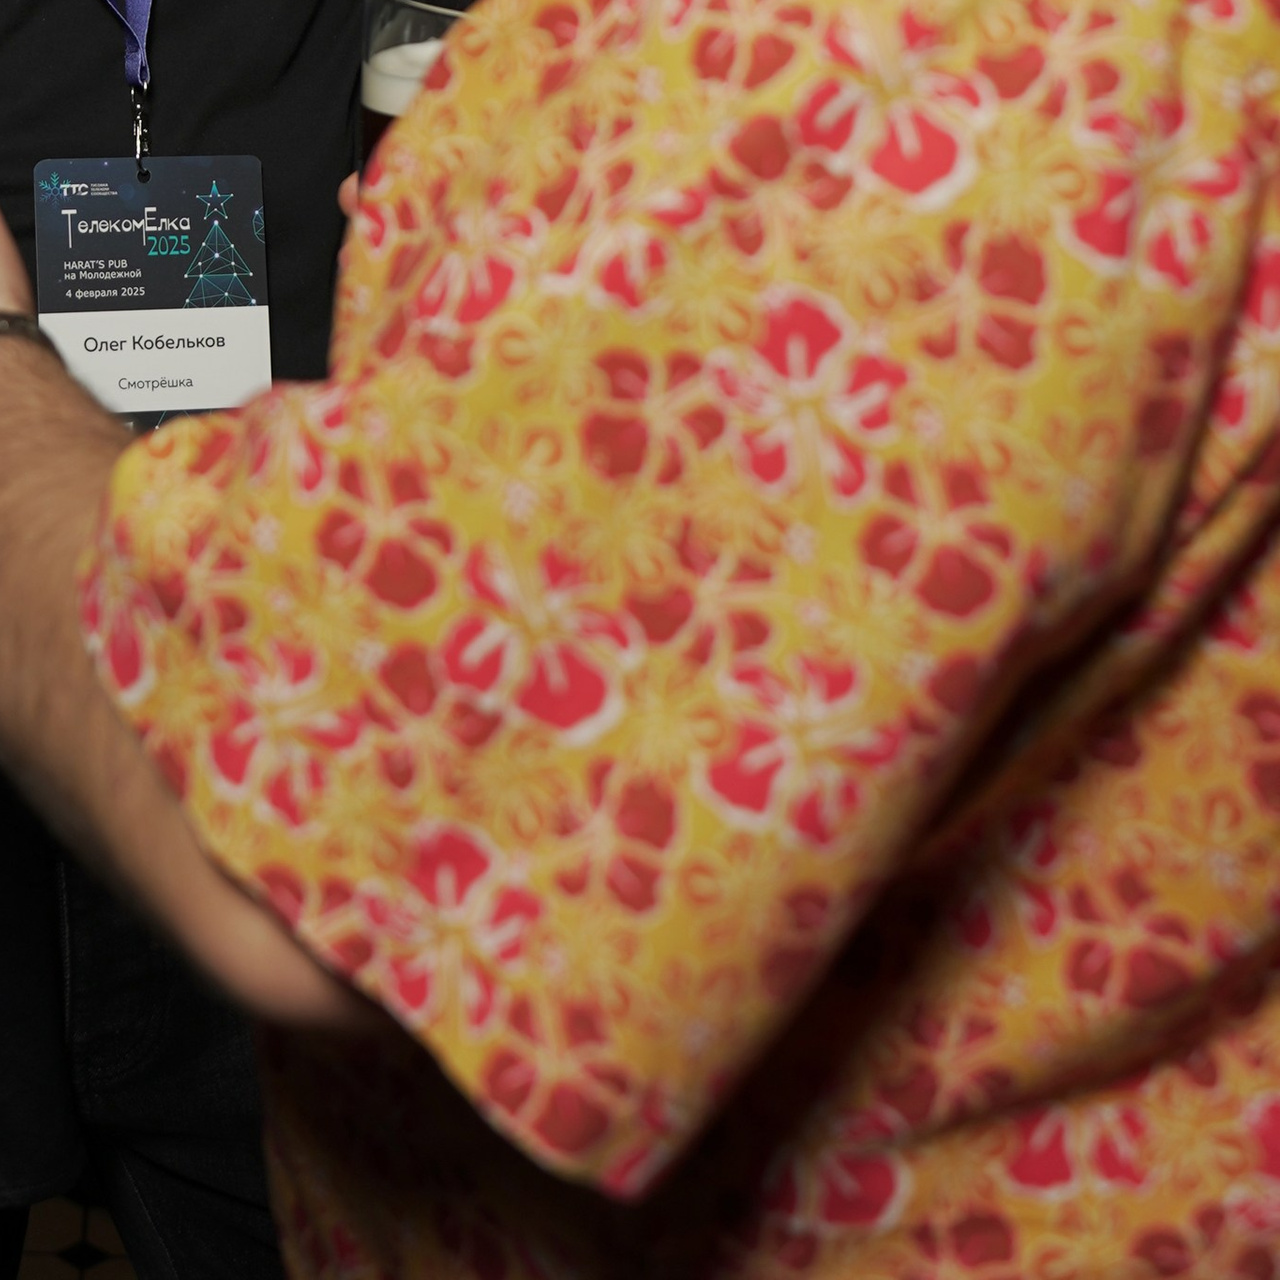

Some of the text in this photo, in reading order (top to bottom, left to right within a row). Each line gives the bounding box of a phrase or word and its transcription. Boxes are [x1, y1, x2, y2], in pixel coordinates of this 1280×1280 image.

[147, 235, 191, 256] 2025
[108, 259, 128, 268] PUB
[79, 268, 142, 281] Молодежной
[65, 287, 146, 299] 4 февраля 2025
[83, 334, 226, 353] Олег Кобельков
[118, 376, 194, 392] Смотрёшка
